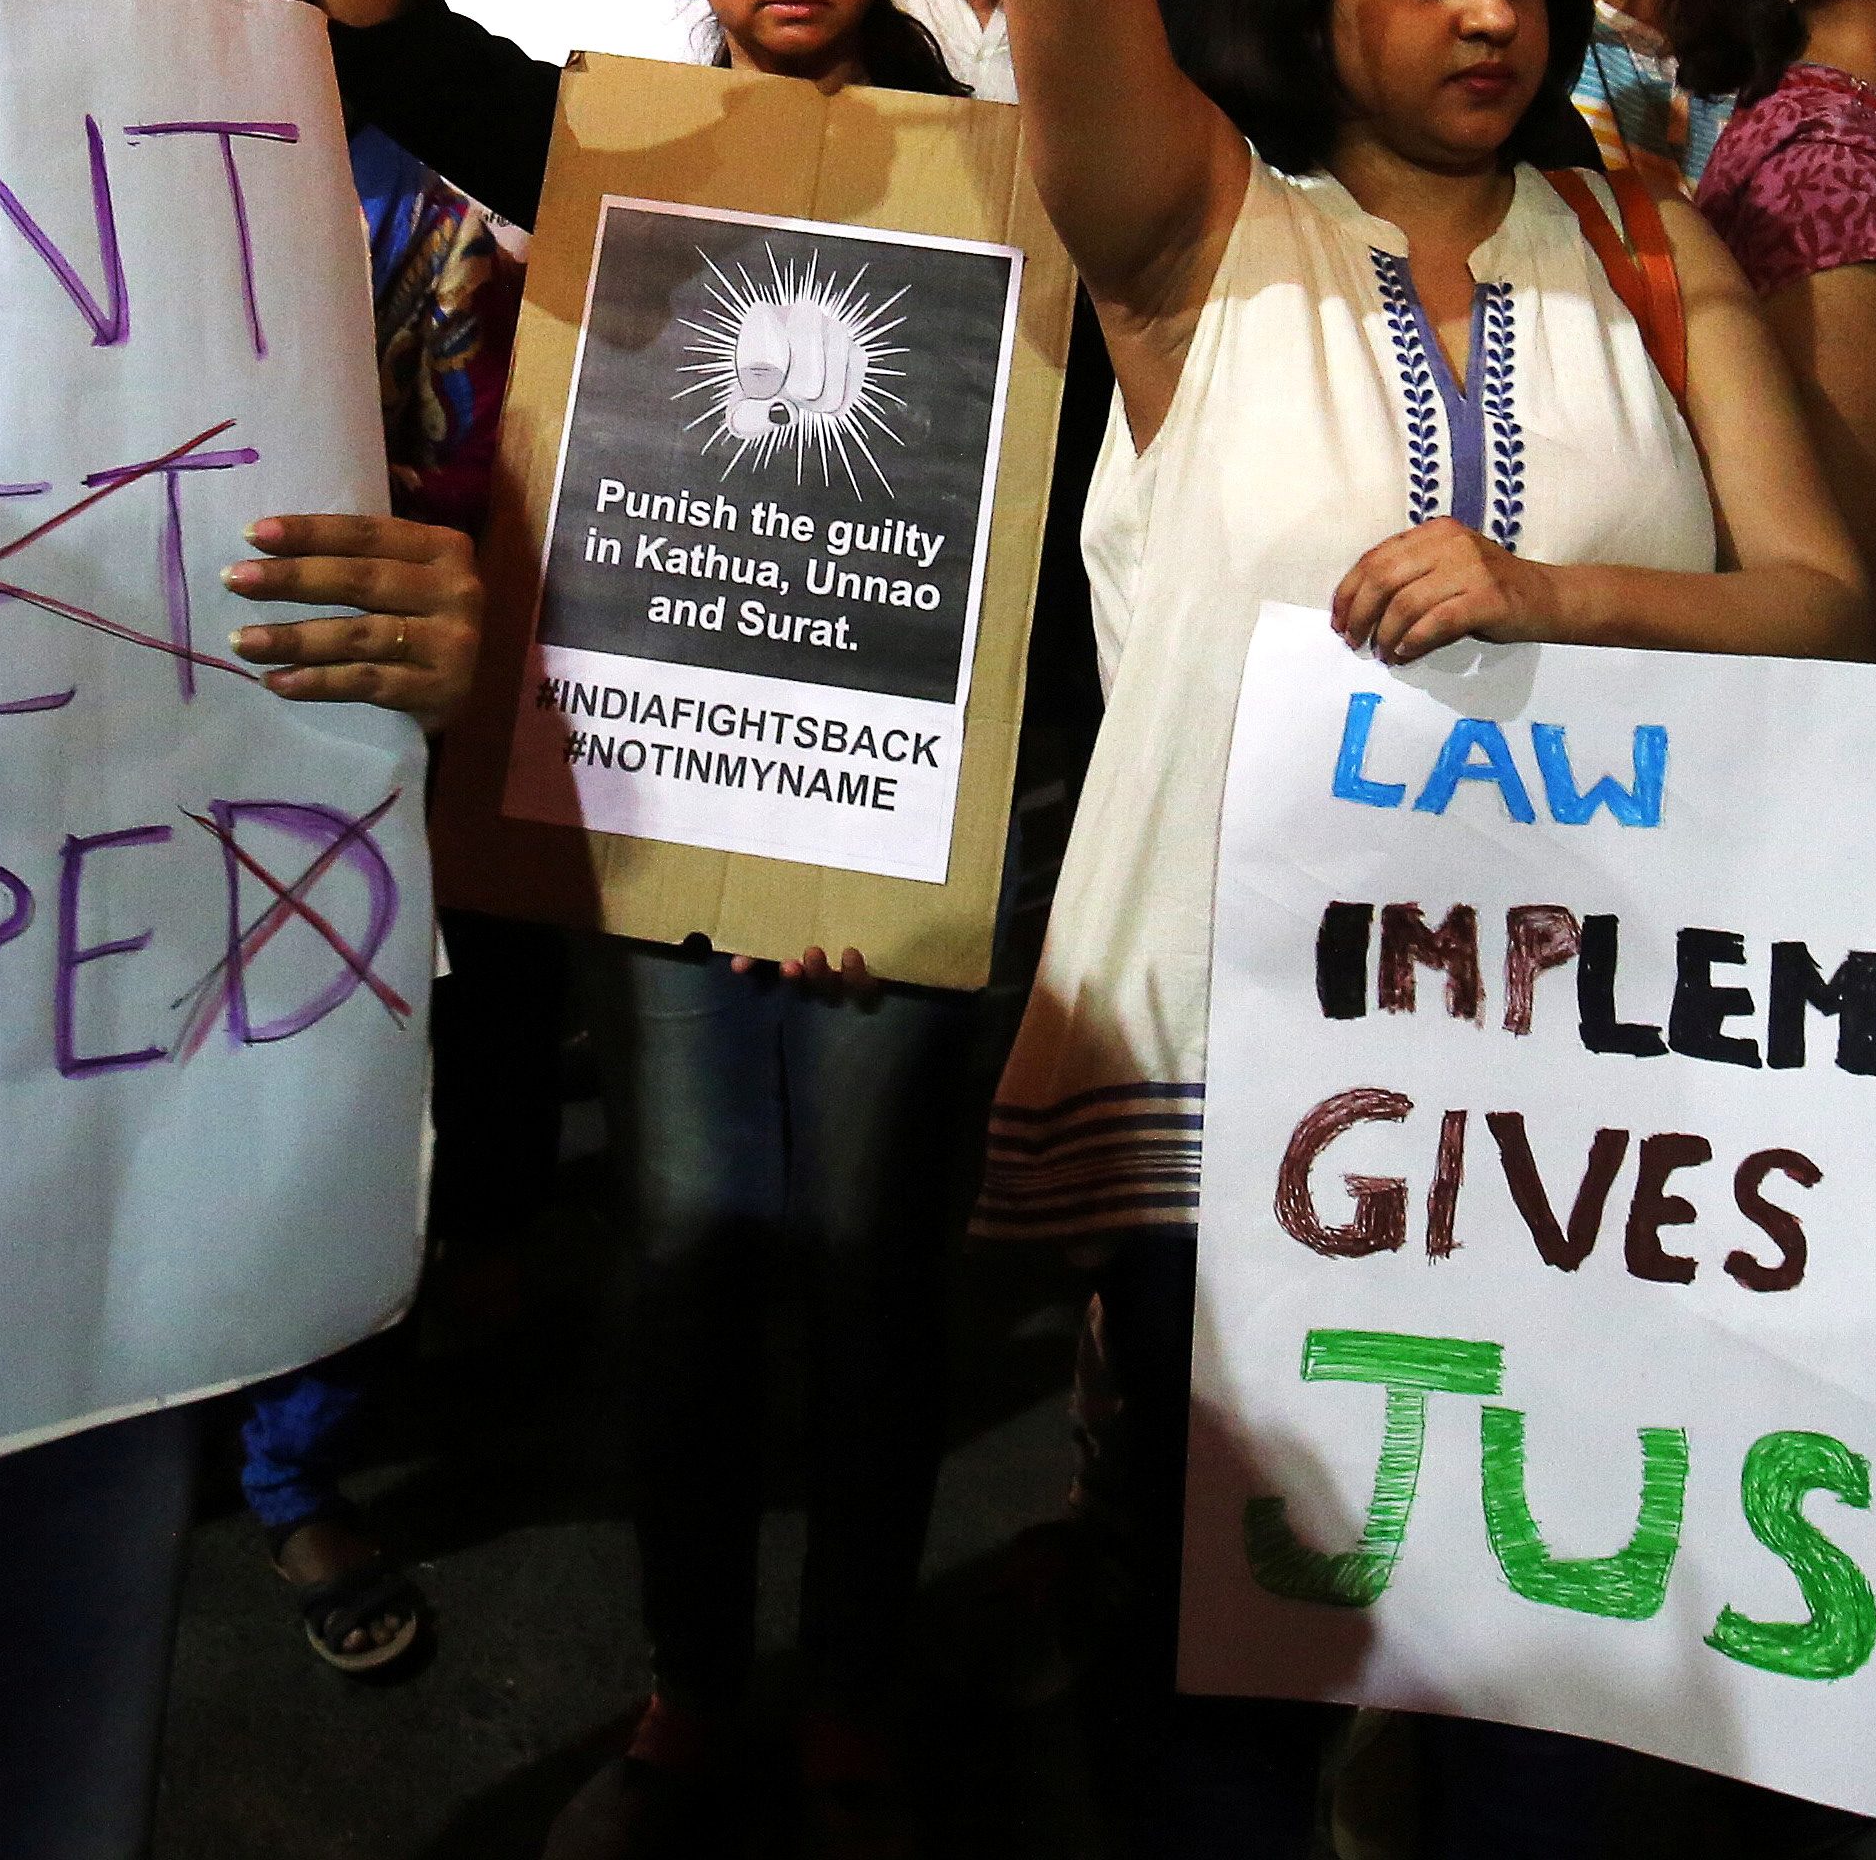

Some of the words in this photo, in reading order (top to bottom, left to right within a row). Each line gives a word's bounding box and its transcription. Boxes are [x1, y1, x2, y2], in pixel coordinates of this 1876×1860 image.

[595, 478, 738, 532] Punish
[750, 501, 816, 543] the
[826, 518, 946, 568] guilty
[583, 527, 621, 566] in
[634, 533, 791, 595] Kathua,
[805, 559, 942, 612] Unnao
[647, 594, 726, 632] and
[736, 600, 859, 652] Surat.
[535, 676, 942, 768] #INDIAFIGHTSBACK
[1332, 691, 1668, 829] LAW
[562, 728, 898, 813] #NOTINMYNAME
[1274, 1088, 1823, 1292] GIVES
